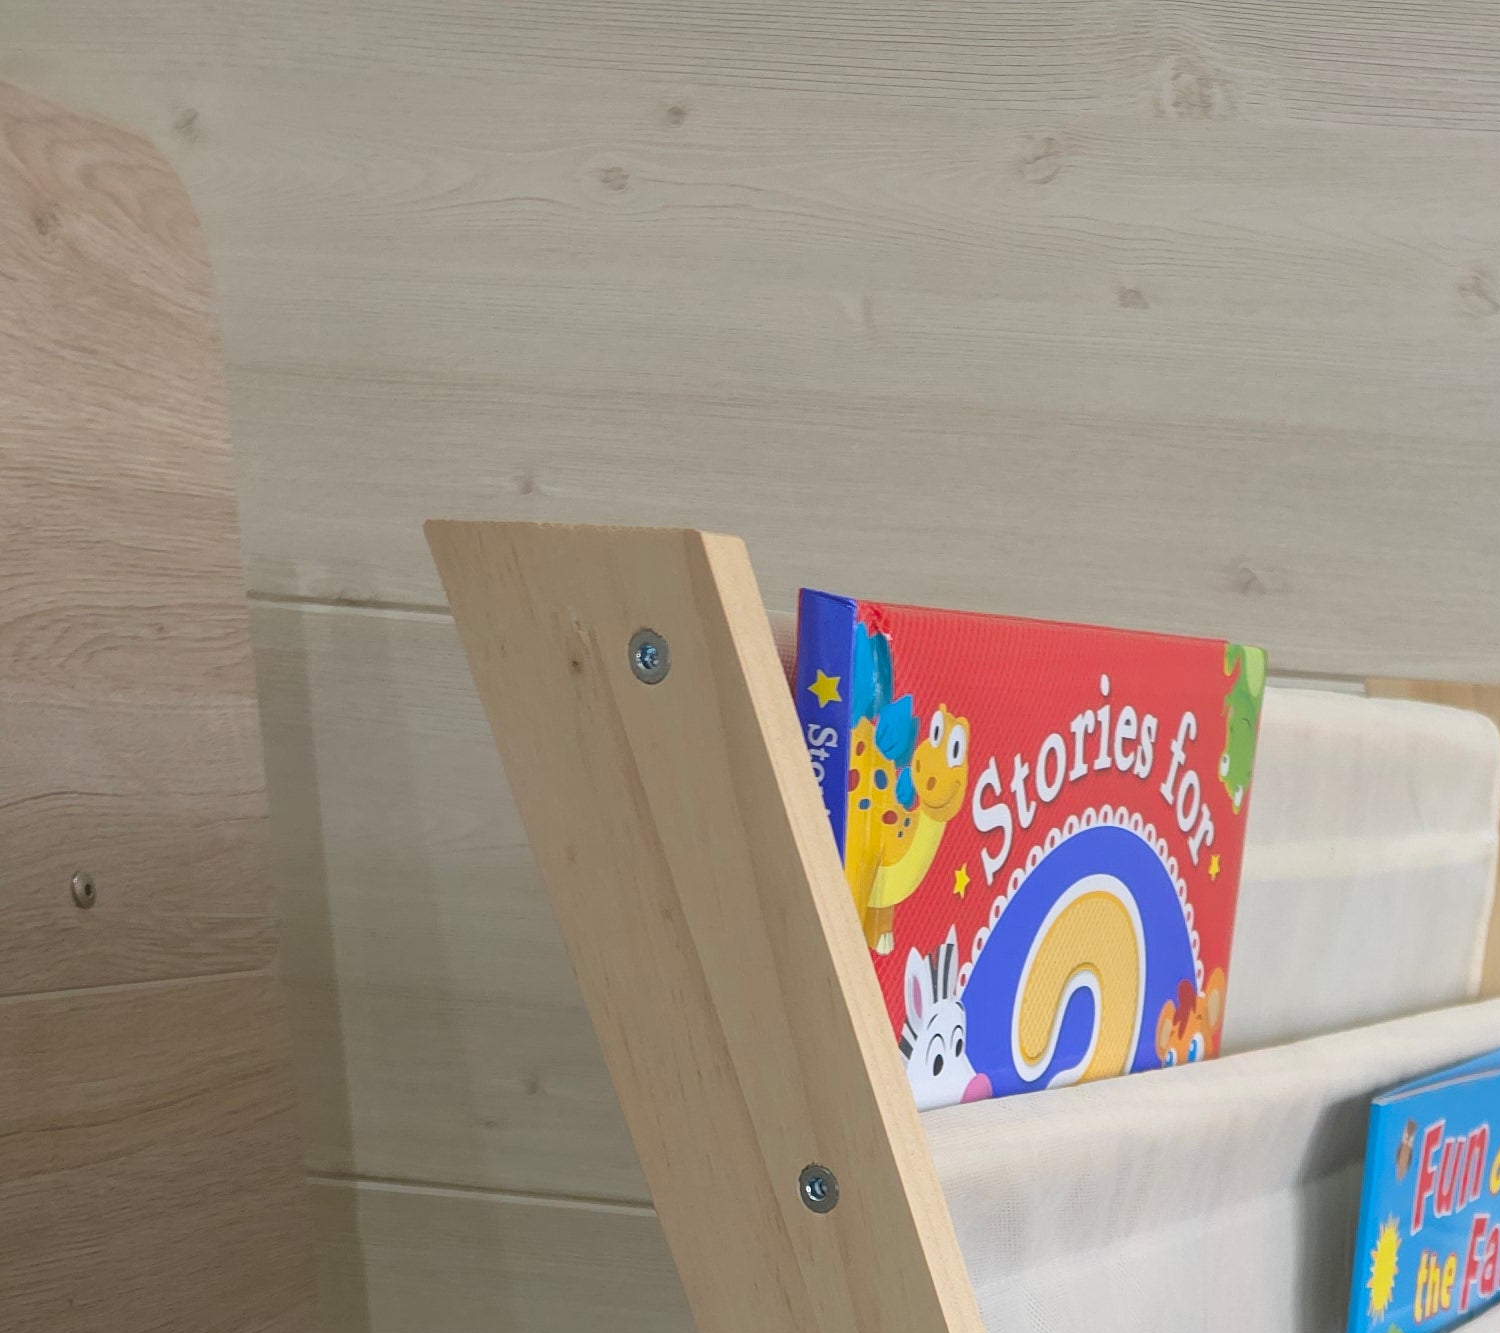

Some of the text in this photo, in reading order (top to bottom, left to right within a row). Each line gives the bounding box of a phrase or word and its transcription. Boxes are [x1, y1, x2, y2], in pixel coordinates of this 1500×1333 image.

[972, 675, 1216, 886] Stories for
[1410, 1119, 1490, 1236] Fun
[1414, 1250, 1458, 1325] the
